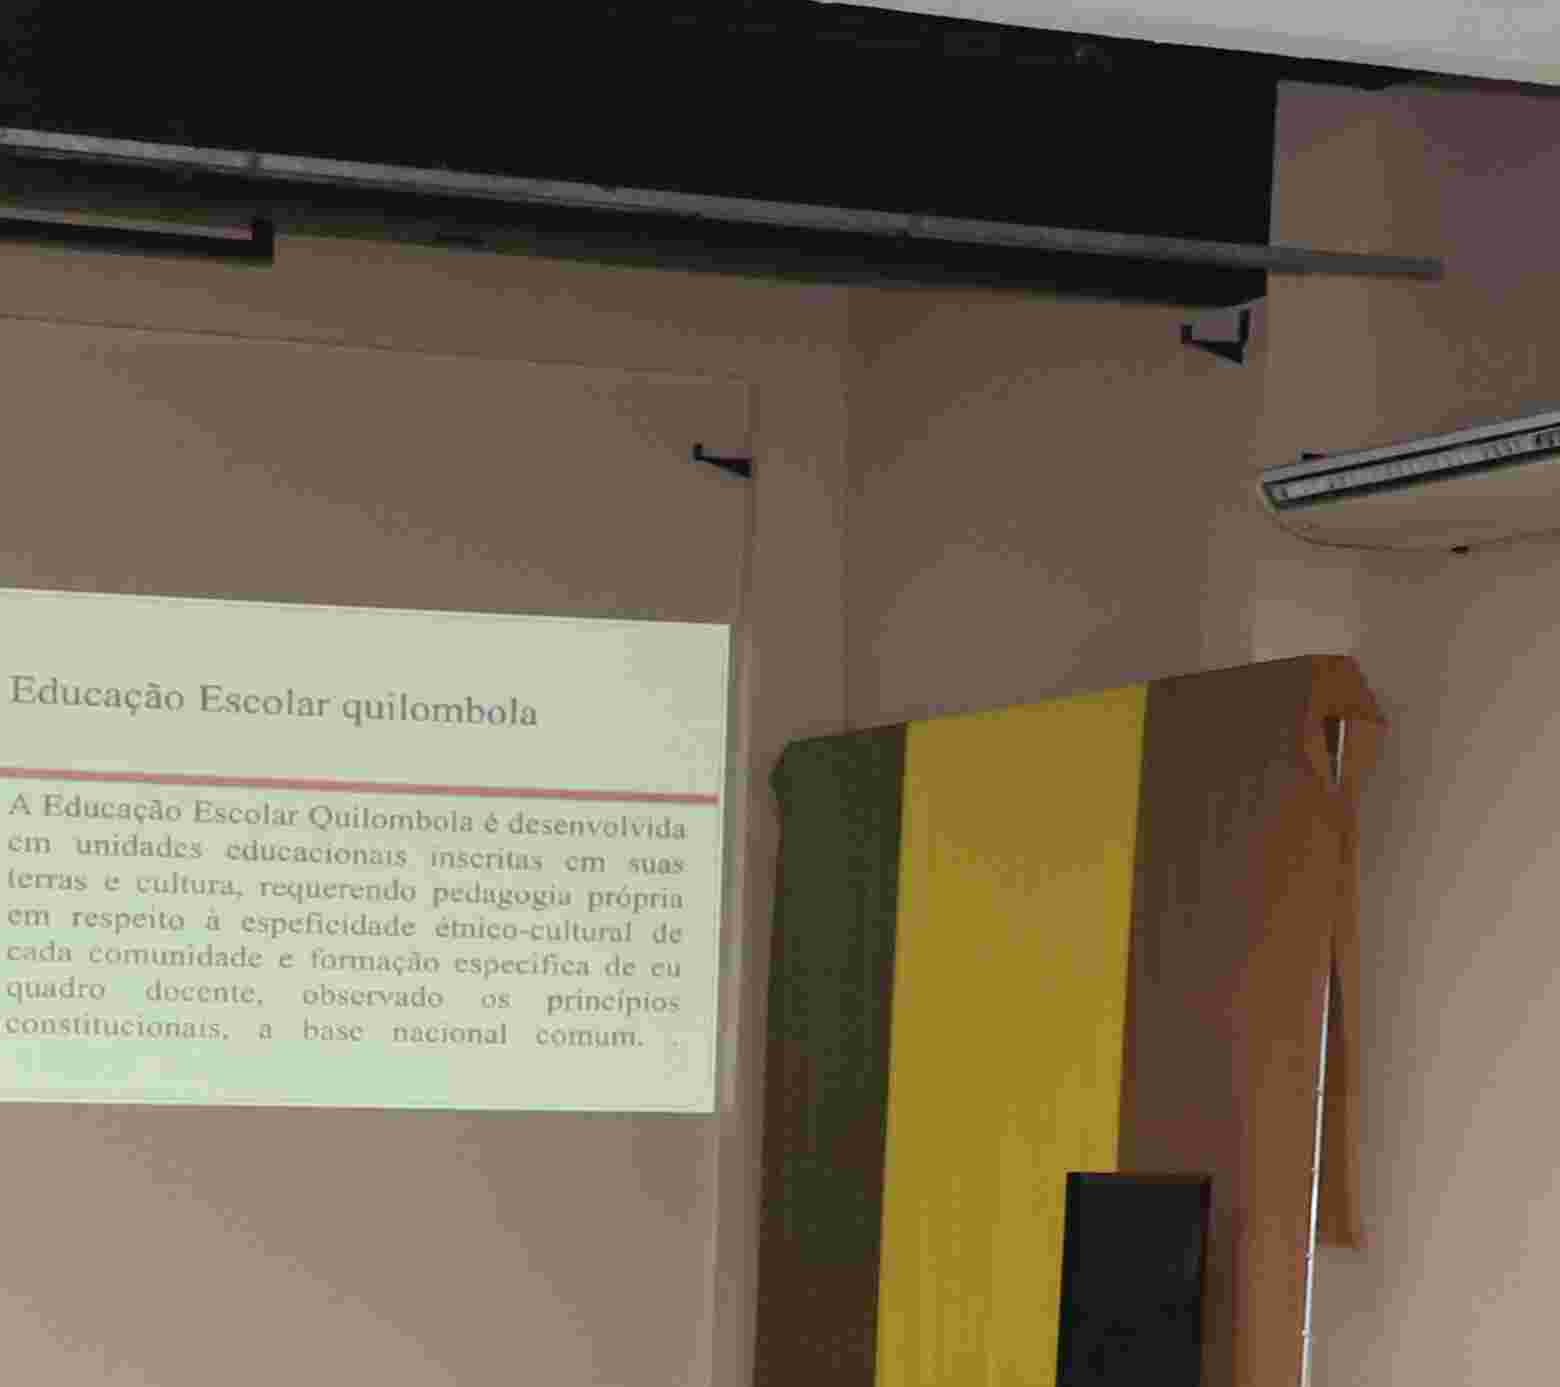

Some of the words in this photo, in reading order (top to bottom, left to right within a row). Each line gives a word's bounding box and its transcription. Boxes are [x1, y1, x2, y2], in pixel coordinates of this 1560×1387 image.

[8, 674, 185, 718] Educação
[199, 684, 330, 717] Escolar
[343, 691, 538, 727] quilombola
[8, 793, 32, 815] A
[42, 793, 182, 824] Educação
[193, 800, 300, 825] Escolar
[308, 804, 473, 832] Quilombola
[484, 812, 498, 833] é
[509, 811, 687, 840] desenvolvida
[7, 835, 51, 854] em
[75, 833, 203, 858] unidades
[226, 839, 408, 867] educacionais
[431, 848, 544, 871] inscritas
[565, 854, 607, 872] em
[628, 855, 685, 874] suas
[7, 867, 88, 891] terras
[105, 872, 120, 890] e
[136, 871, 244, 900] cultura,
[259, 879, 417, 904] requerendo
[433, 880, 572, 911] pedagogia
[588, 884, 684, 913] própria
[7, 907, 50, 927] em
[71, 904, 185, 934] respeito
[241, 911, 417, 939] espeficidade
[435, 916, 631, 943] étnico-cultural
[652, 921, 683, 944] de
[7, 939, 73, 962] cada
[88, 944, 263, 968] comunidade
[279, 952, 294, 968] e
[312, 946, 441, 977] formação
[605, 954, 636, 977] de
[7, 976, 106, 1004] quadro
[145, 979, 263, 1006] docente,
[303, 984, 443, 1008] observado
[481, 991, 511, 1009] os
[5, 1013, 229, 1041] constitucionais,
[259, 1022, 273, 1040] a
[303, 1017, 364, 1041] base
[392, 1023, 507, 1045] nacional
[536, 1028, 645, 1047] comum.
